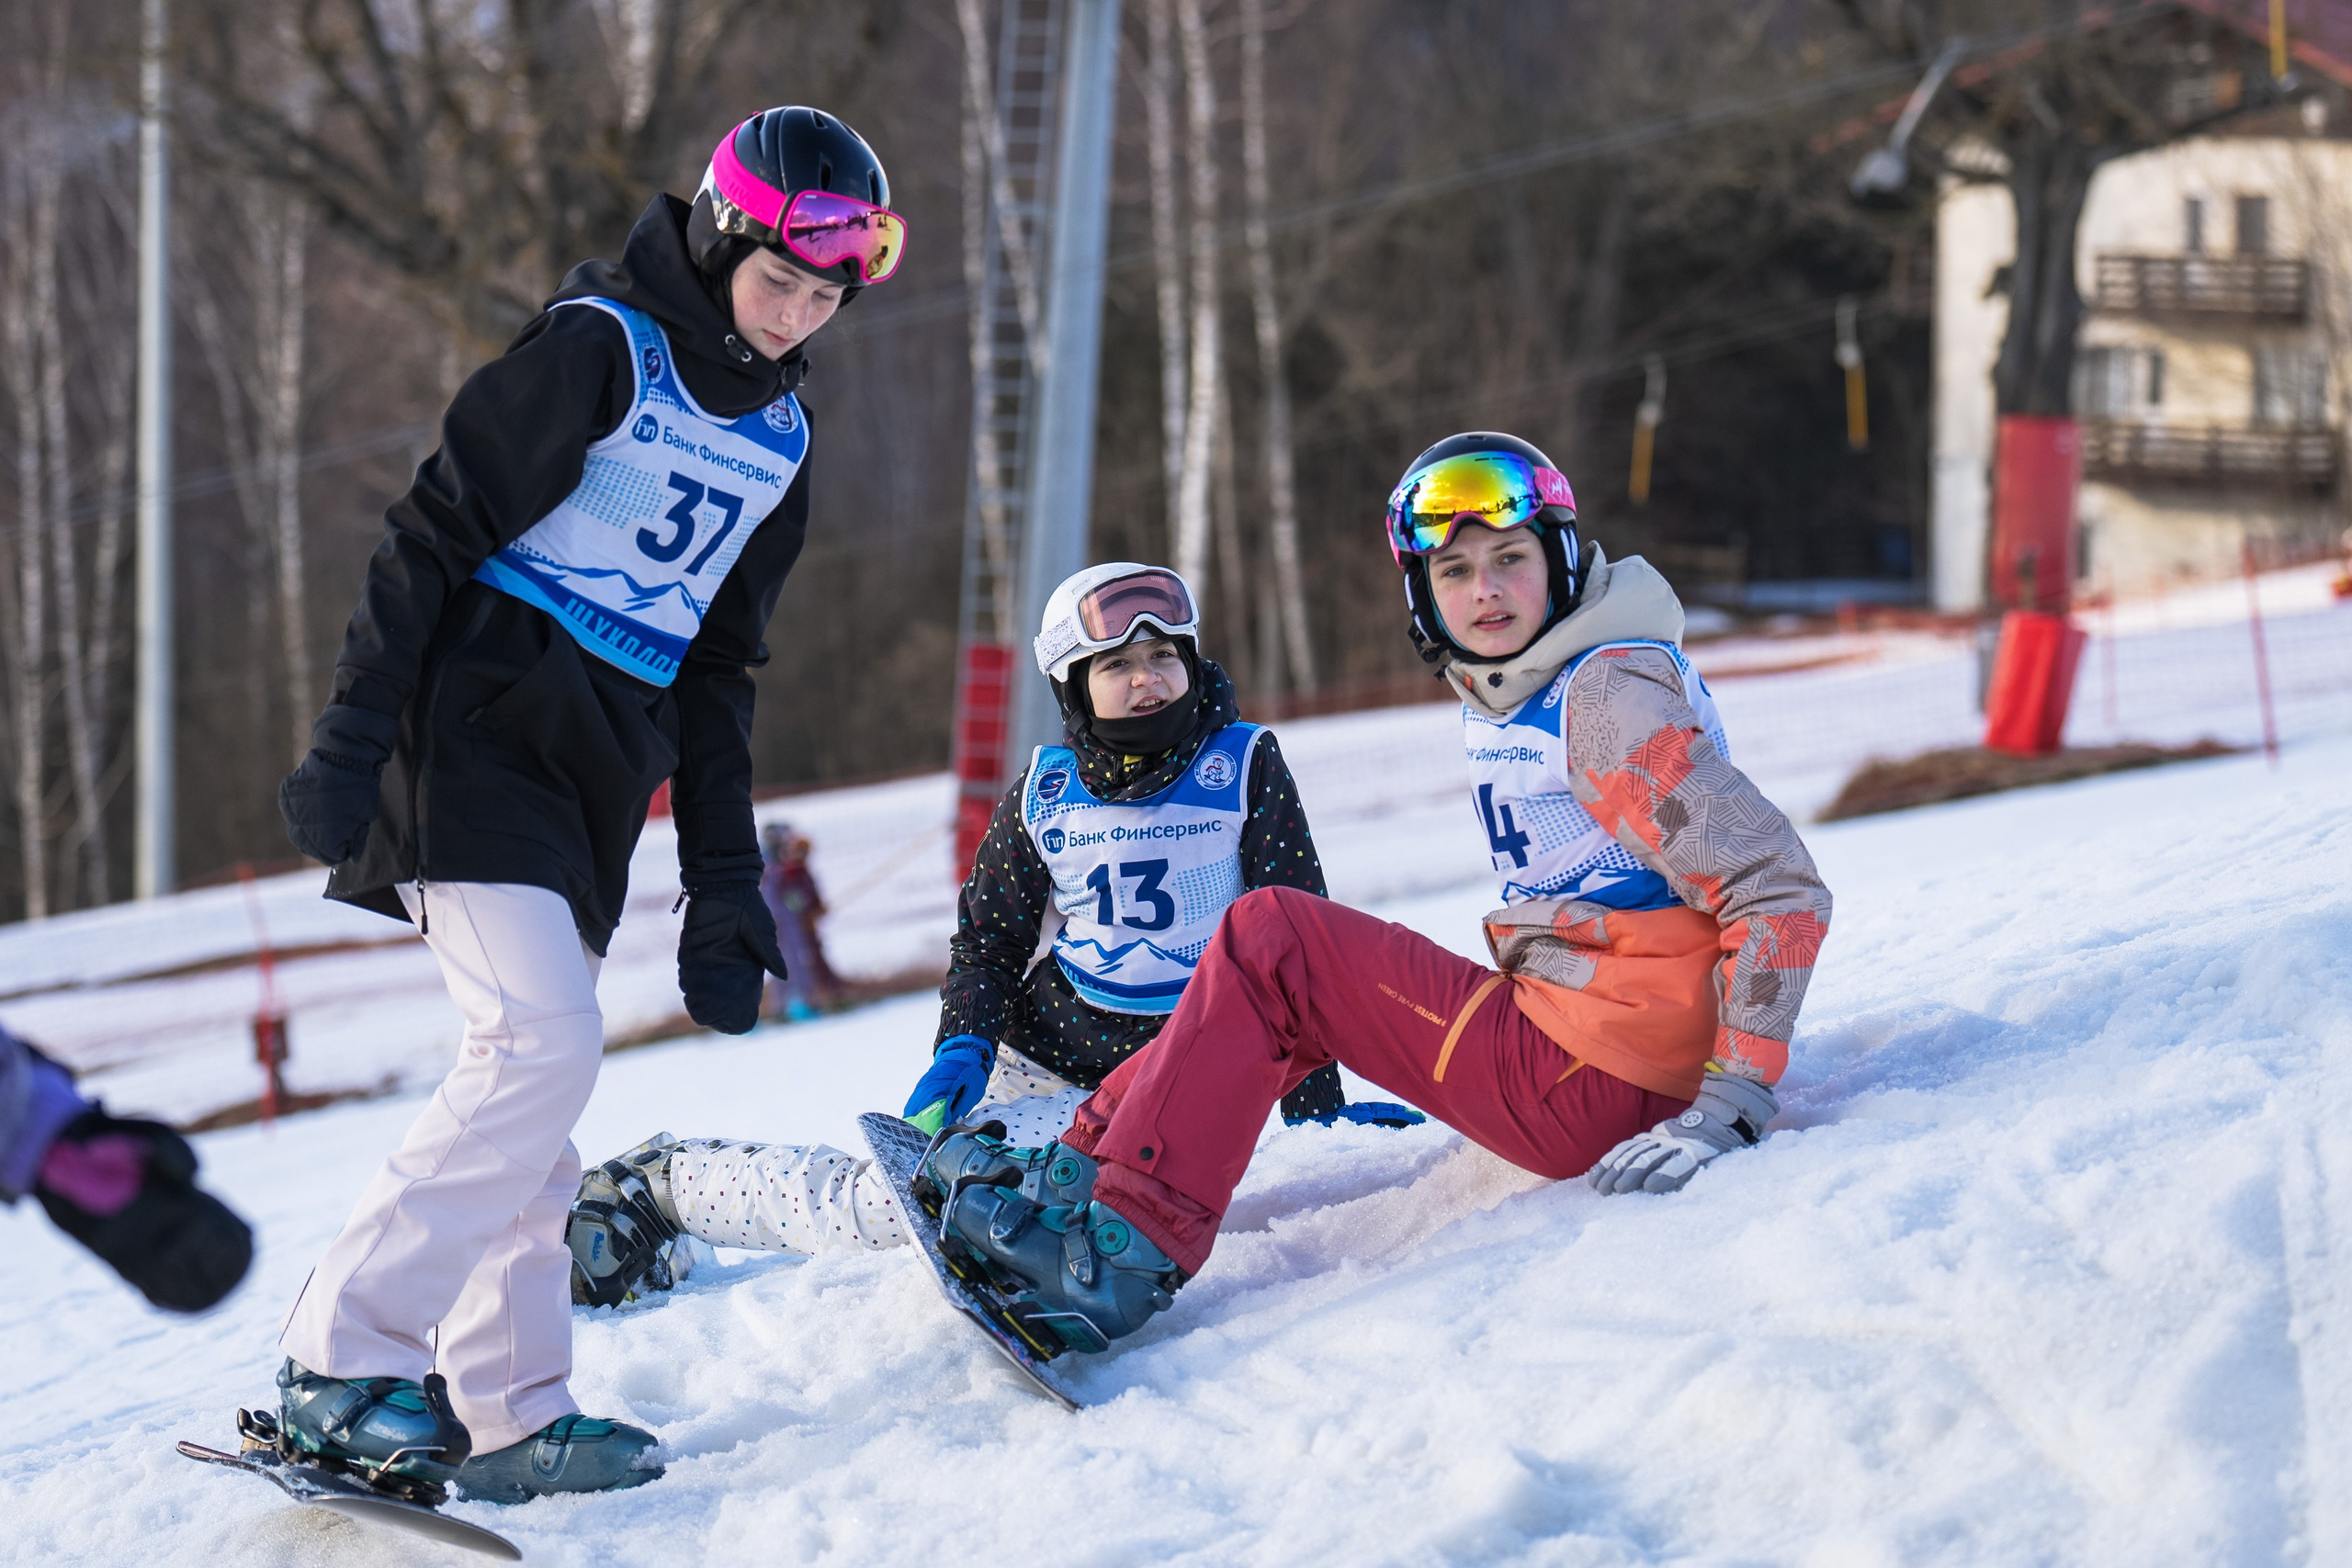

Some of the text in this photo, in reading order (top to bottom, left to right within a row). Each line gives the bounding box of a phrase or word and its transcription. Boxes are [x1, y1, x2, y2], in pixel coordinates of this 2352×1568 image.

[662, 425, 783, 490] Банк Финсервис
[636, 469, 745, 577] 37
[1069, 819, 1223, 848] Банк Финсервис
[1471, 783, 1532, 872] 4
[1086, 858, 1176, 931] 13
[1414, 1004, 1442, 1025] PROTEST
